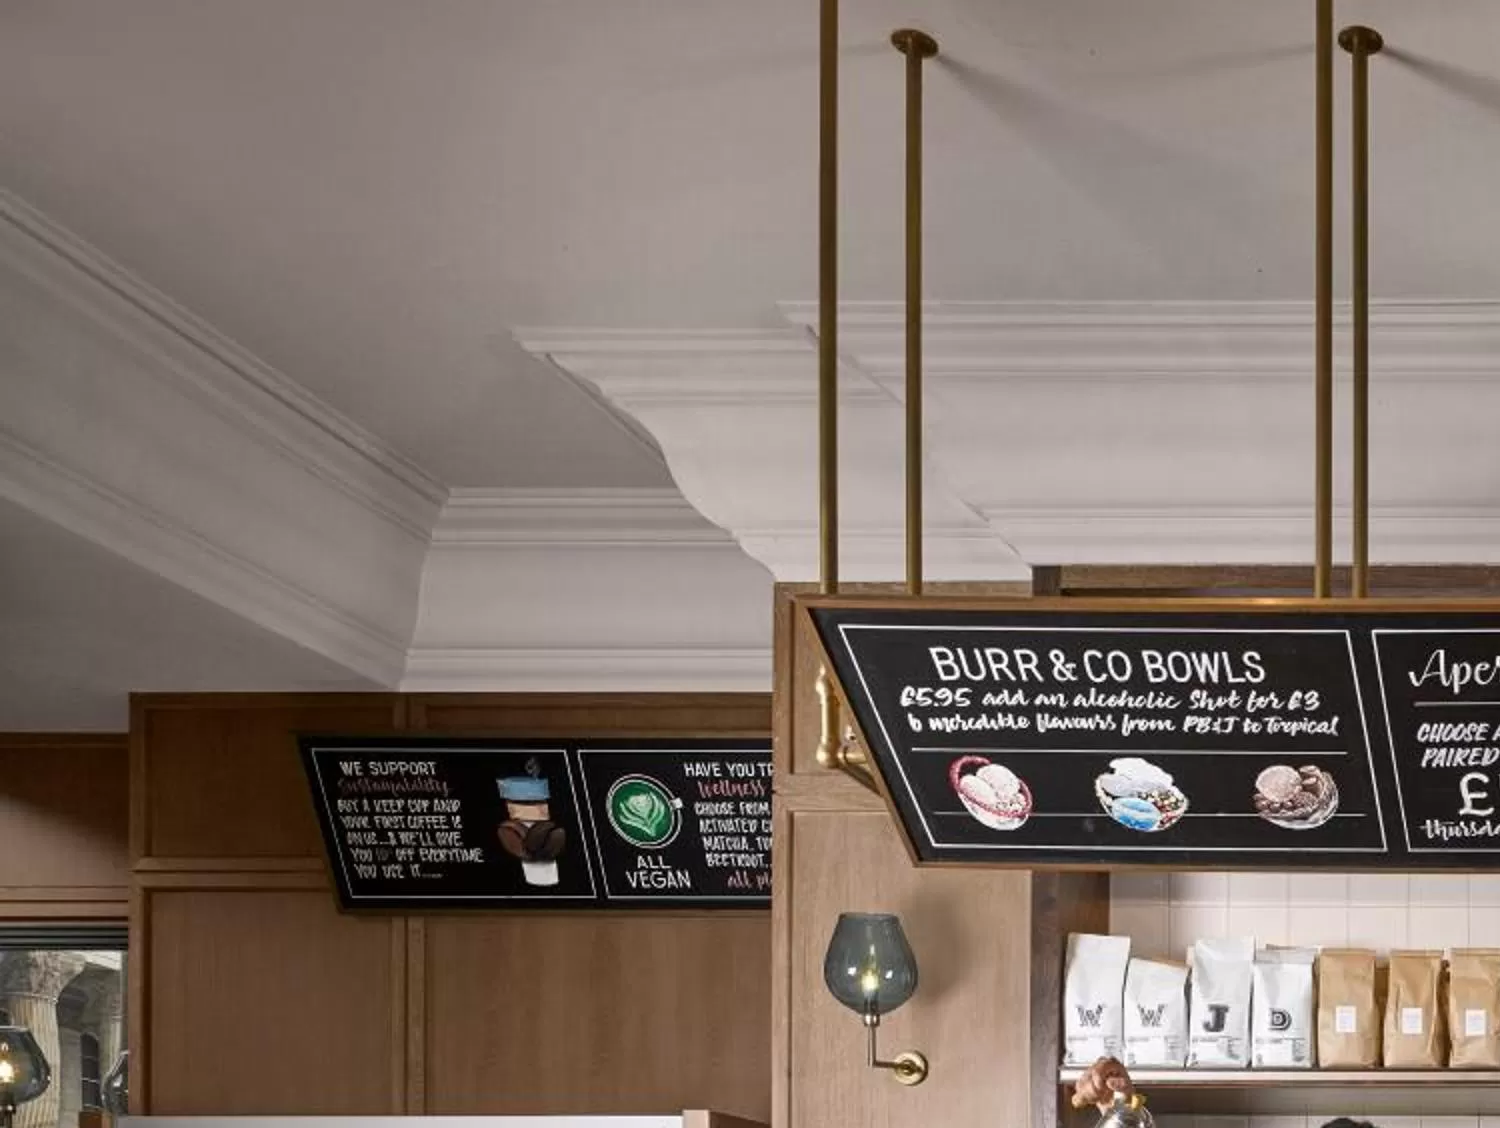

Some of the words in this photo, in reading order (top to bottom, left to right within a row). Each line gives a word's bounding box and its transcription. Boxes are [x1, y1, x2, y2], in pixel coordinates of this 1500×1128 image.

[928, 646, 1045, 682] BURR
[1048, 649, 1078, 681] &
[1083, 649, 1133, 682] CO
[1141, 650, 1266, 684] BOWLS
[900, 685, 973, 708] £5.95
[981, 688, 1030, 707] add
[1034, 691, 1067, 708] an
[1072, 687, 1183, 709] alcoholic
[1245, 689, 1286, 713] for
[1287, 689, 1321, 711] £3
[1036, 712, 1118, 733] flavours
[1121, 713, 1176, 737] from
[1242, 716, 1263, 735] to
[1416, 722, 1490, 743] CHOOSE
[1420, 747, 1500, 768] PAIRED
[339, 761, 364, 776] WE
[368, 761, 437, 776] SUPPORT
[683, 762, 722, 777] HAVE
[725, 762, 755, 777] YOU
[697, 779, 767, 799] Wellness
[694, 801, 735, 815] CHOOSE
[739, 801, 771, 815] FROM
[374, 815, 405, 829] FIRST
[407, 815, 450, 829] COFFEE
[699, 818, 757, 833] ACTIVATED
[637, 855, 671, 869] ALL
[626, 869, 691, 889] VEGAN
[1203, 1003, 1230, 1032] J
[1267, 1007, 1292, 1031] D
